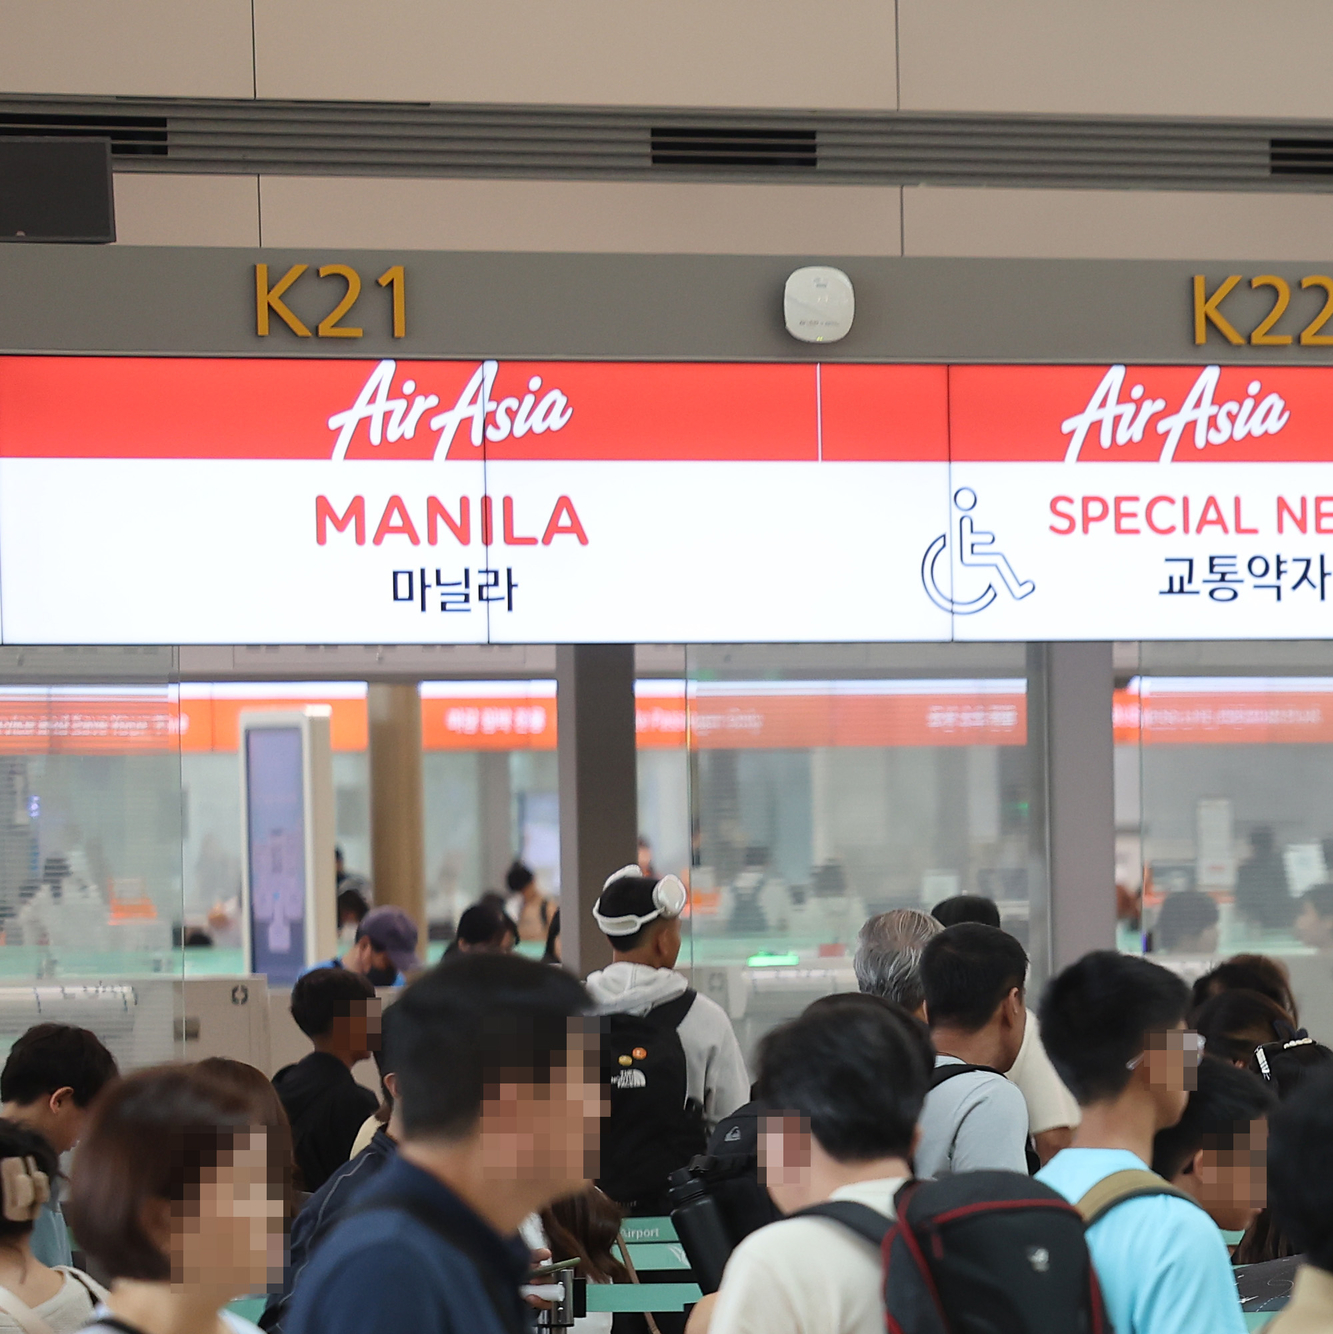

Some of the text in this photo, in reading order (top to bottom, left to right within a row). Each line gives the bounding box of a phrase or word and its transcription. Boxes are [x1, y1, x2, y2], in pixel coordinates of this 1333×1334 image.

[255, 262, 407, 338] K21
[314, 495, 589, 546] MANILA
[1048, 495, 1259, 535] SPECIAL
[391, 566, 519, 613] 마닐라
[1157, 553, 1333, 602] 교통약자
